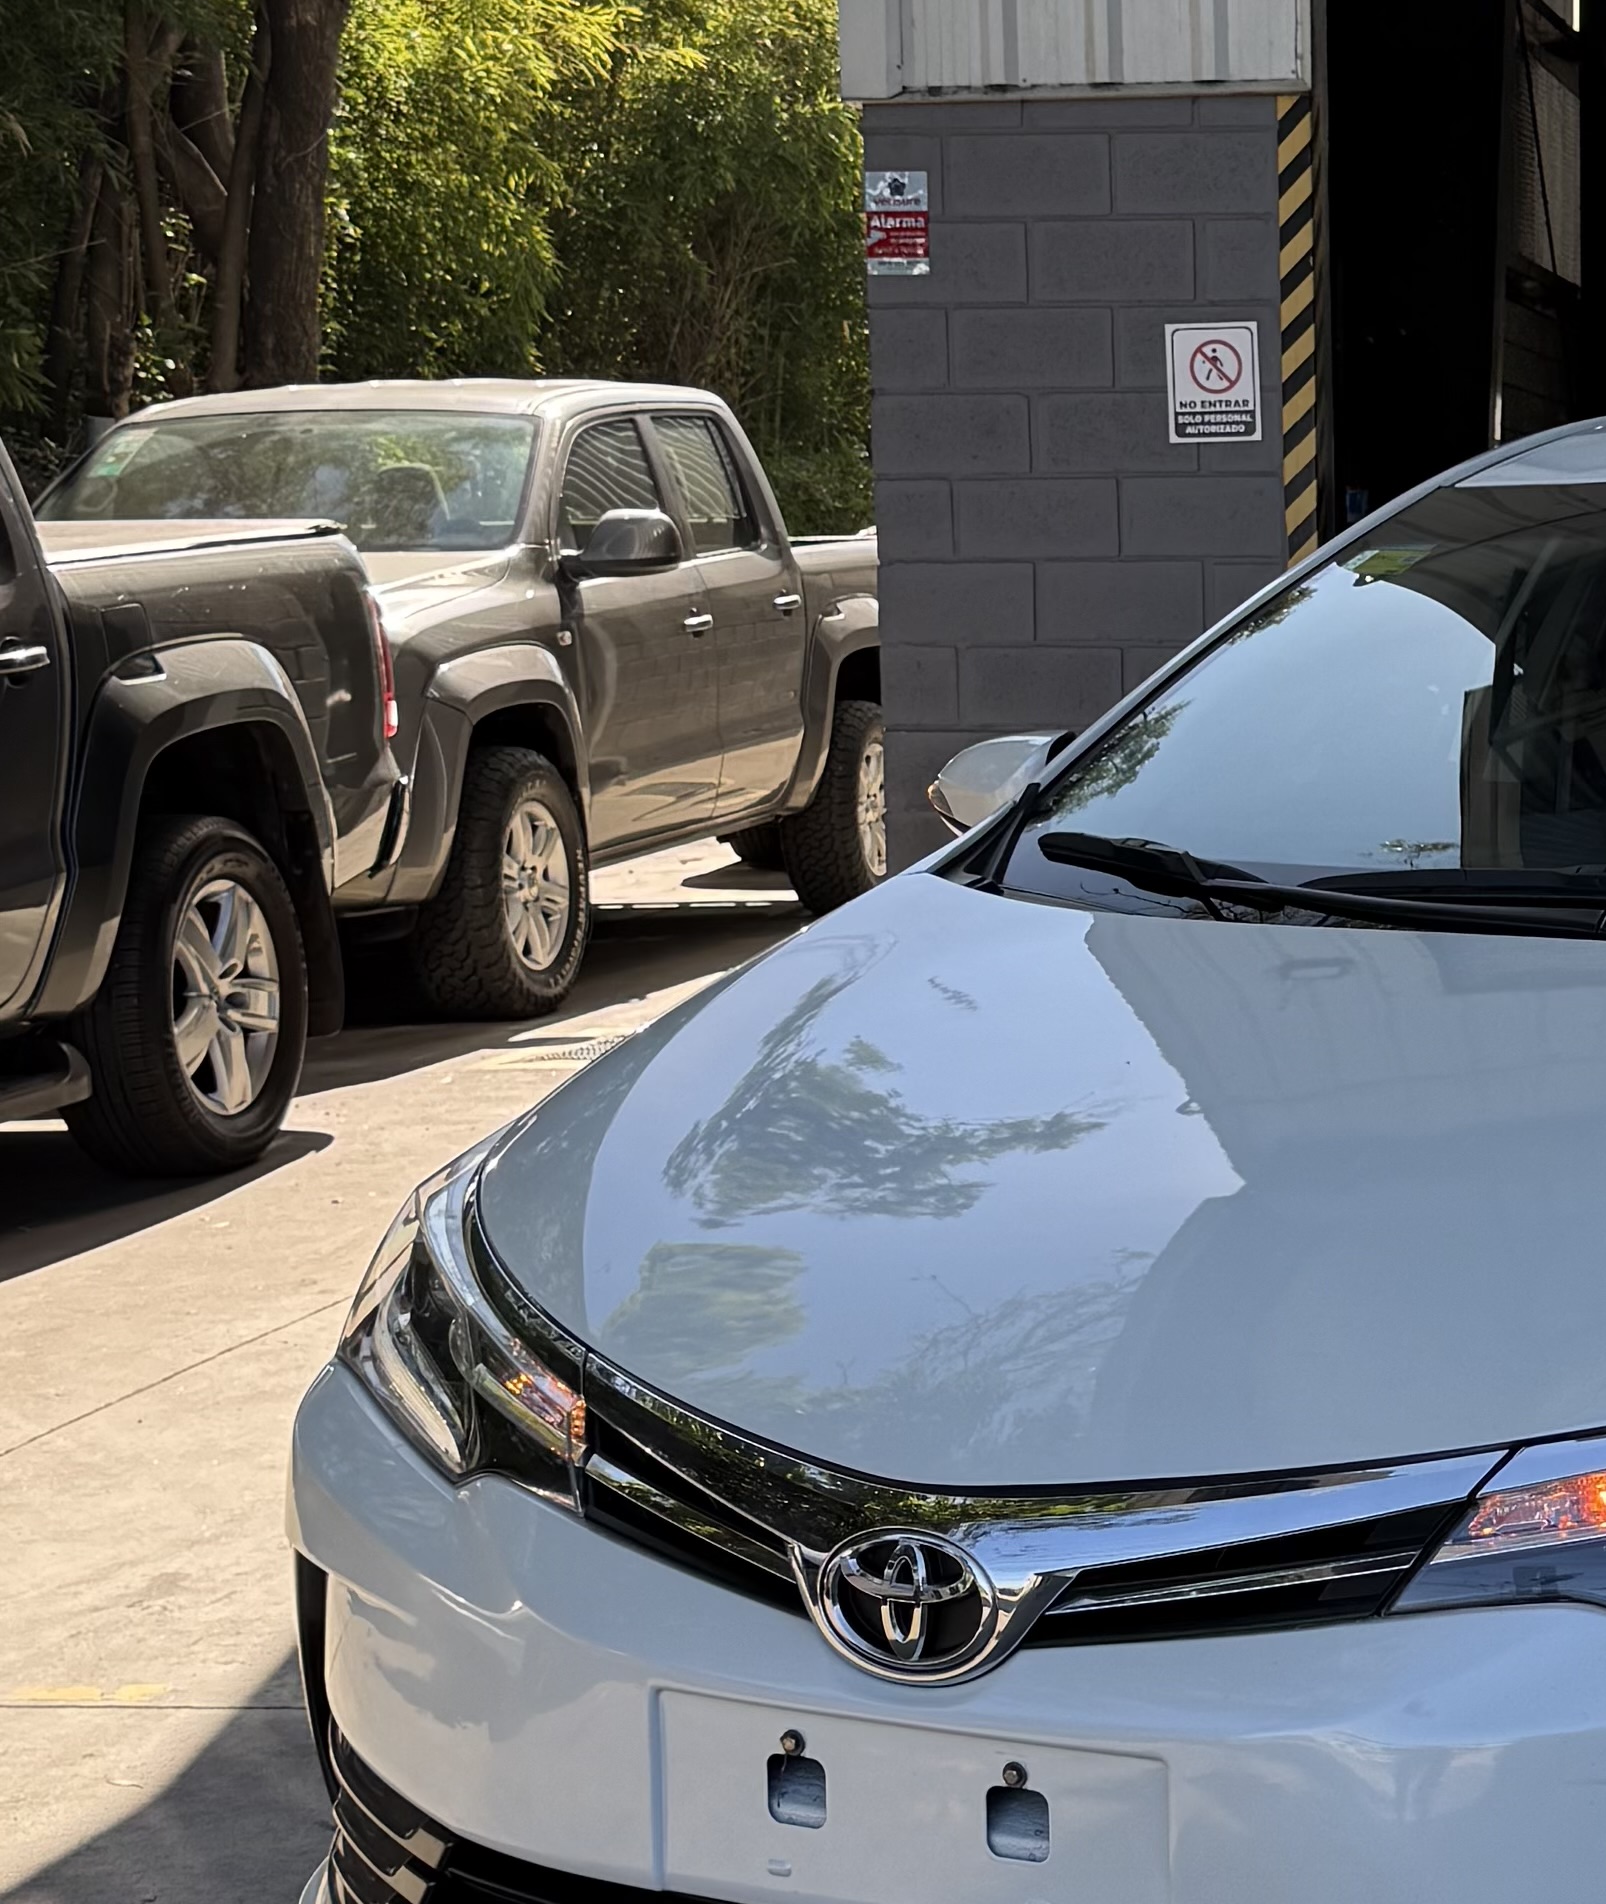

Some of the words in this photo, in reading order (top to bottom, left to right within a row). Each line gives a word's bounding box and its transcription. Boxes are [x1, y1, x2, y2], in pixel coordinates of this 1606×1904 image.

[870, 213, 925, 228] Alarma
[1179, 400, 1197, 409] NO
[1201, 399, 1250, 408] ENTRAR
[1178, 414, 1202, 423] SOLO
[1204, 414, 1253, 422] PERSONAL
[1185, 424, 1245, 433] AUTORIZADO
